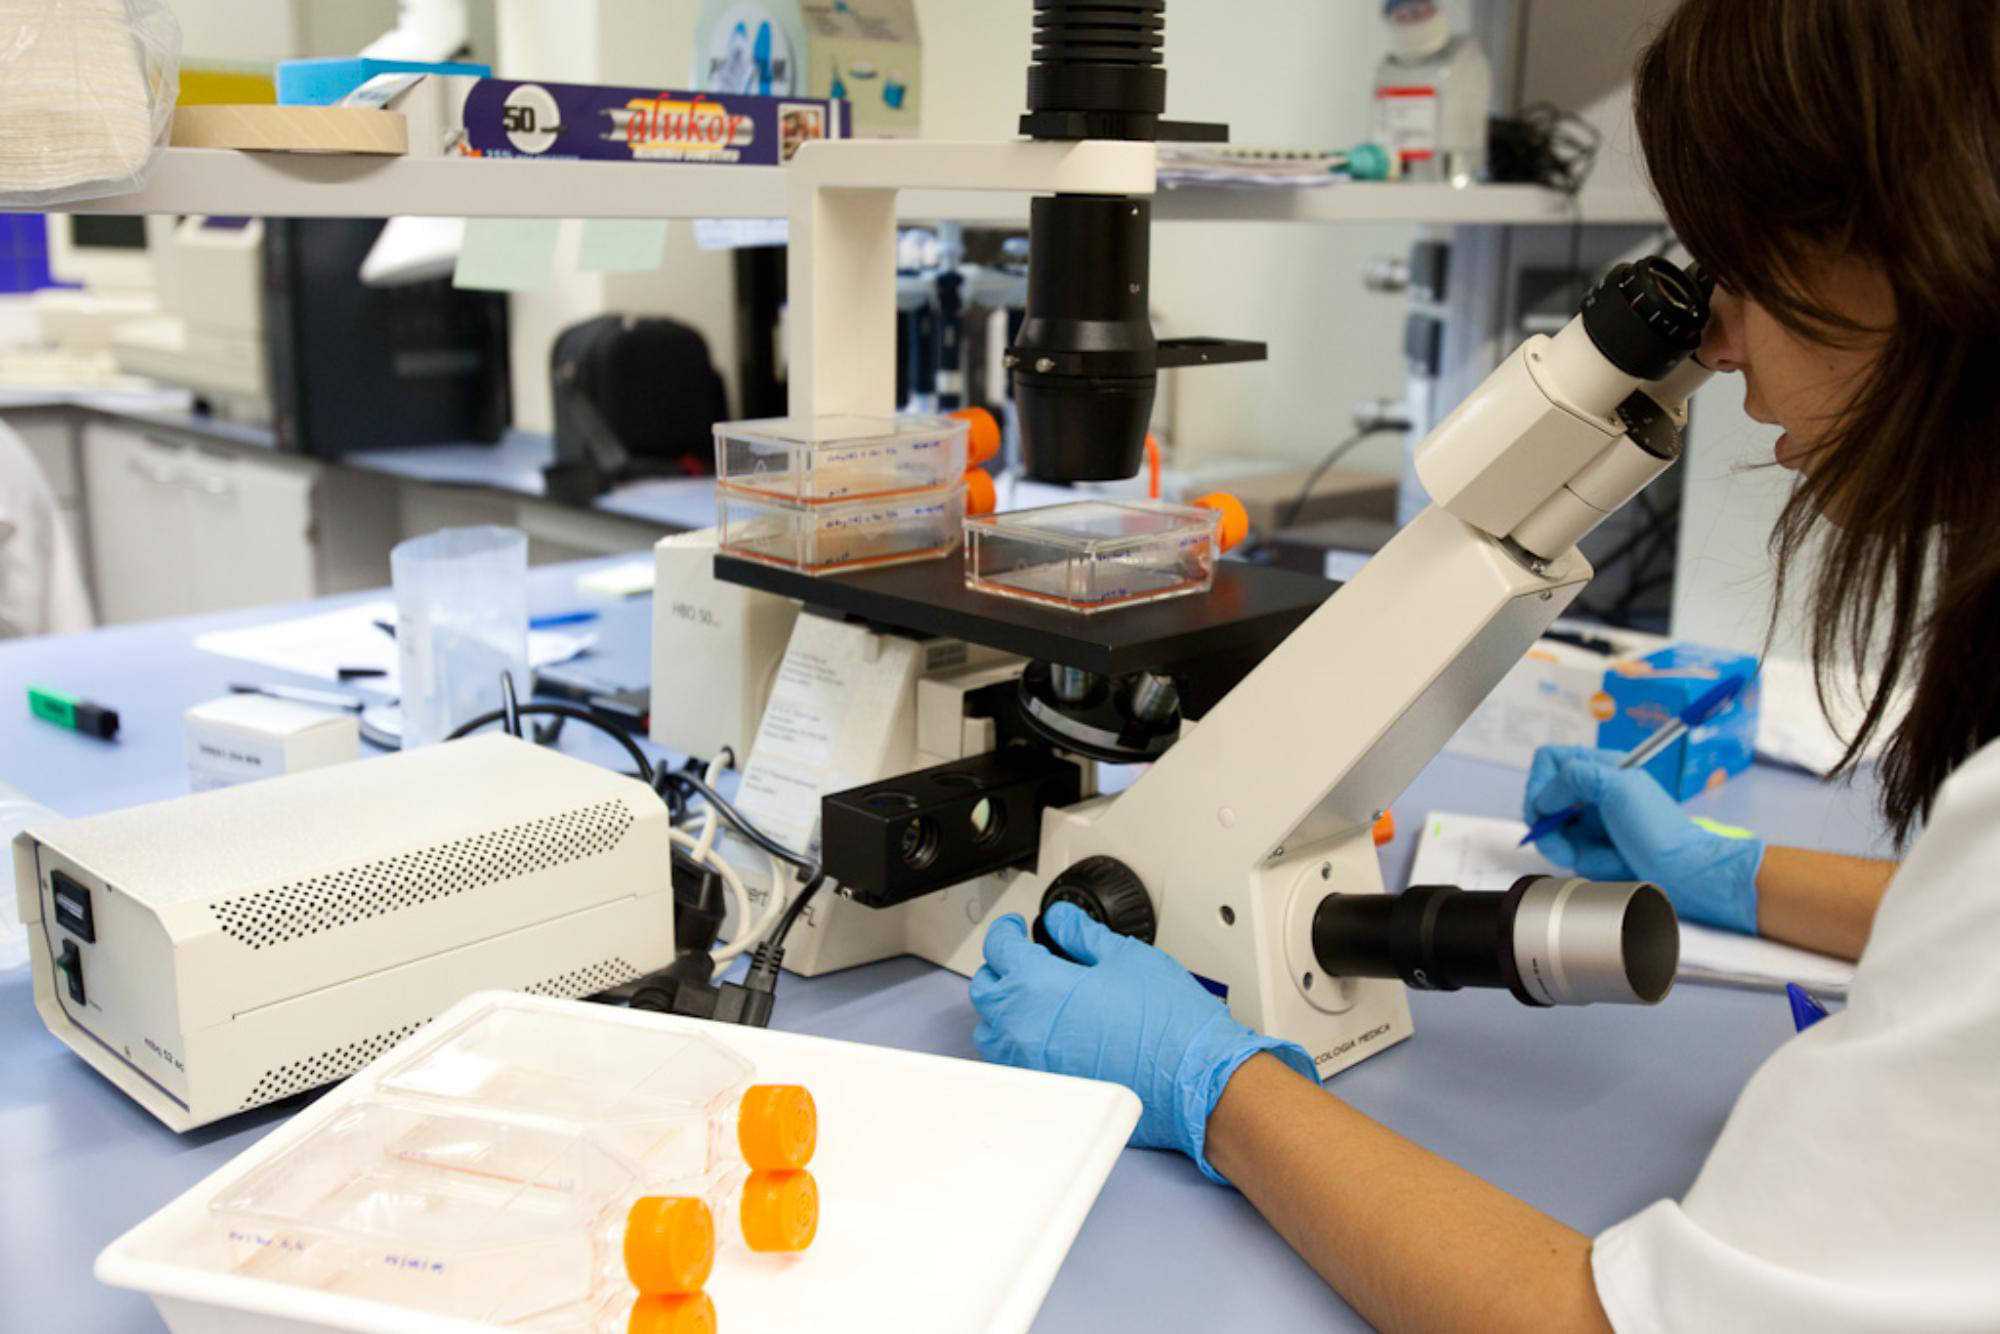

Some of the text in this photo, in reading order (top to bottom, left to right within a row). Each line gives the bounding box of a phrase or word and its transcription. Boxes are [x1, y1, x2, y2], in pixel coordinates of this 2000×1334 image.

[503, 106, 536, 133] 50
[625, 91, 743, 144] alukor
[1315, 1023, 1390, 1066] COLOGIA MEDICA
